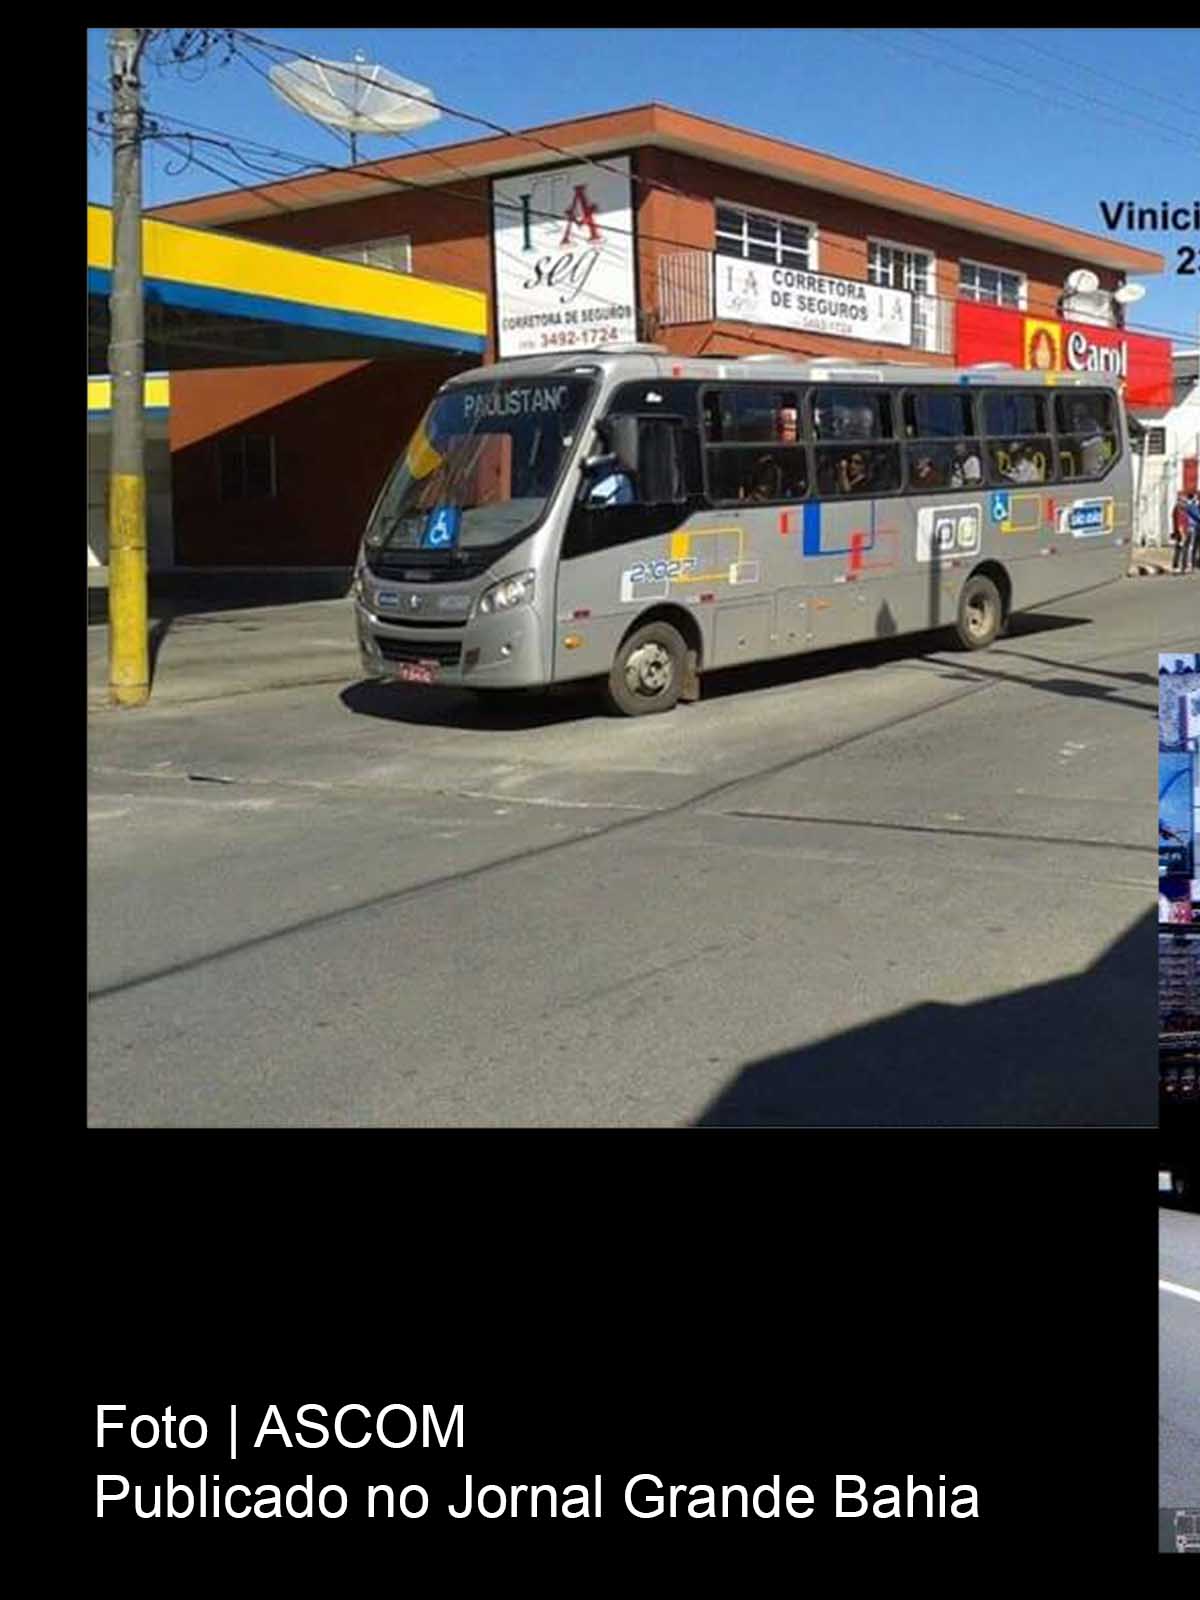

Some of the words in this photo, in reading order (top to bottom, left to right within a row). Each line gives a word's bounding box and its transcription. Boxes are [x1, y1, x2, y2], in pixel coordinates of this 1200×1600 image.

[523, 251, 600, 304] seg
[771, 269, 868, 301] CORRETORA
[502, 312, 562, 331] CORRETORA
[565, 310, 579, 326] DE
[582, 305, 632, 323] SEGUROS
[770, 291, 792, 309] DE
[796, 296, 869, 322] SEGUROS
[540, 327, 619, 348] 3492-1724
[1068, 331, 1128, 377] Carol
